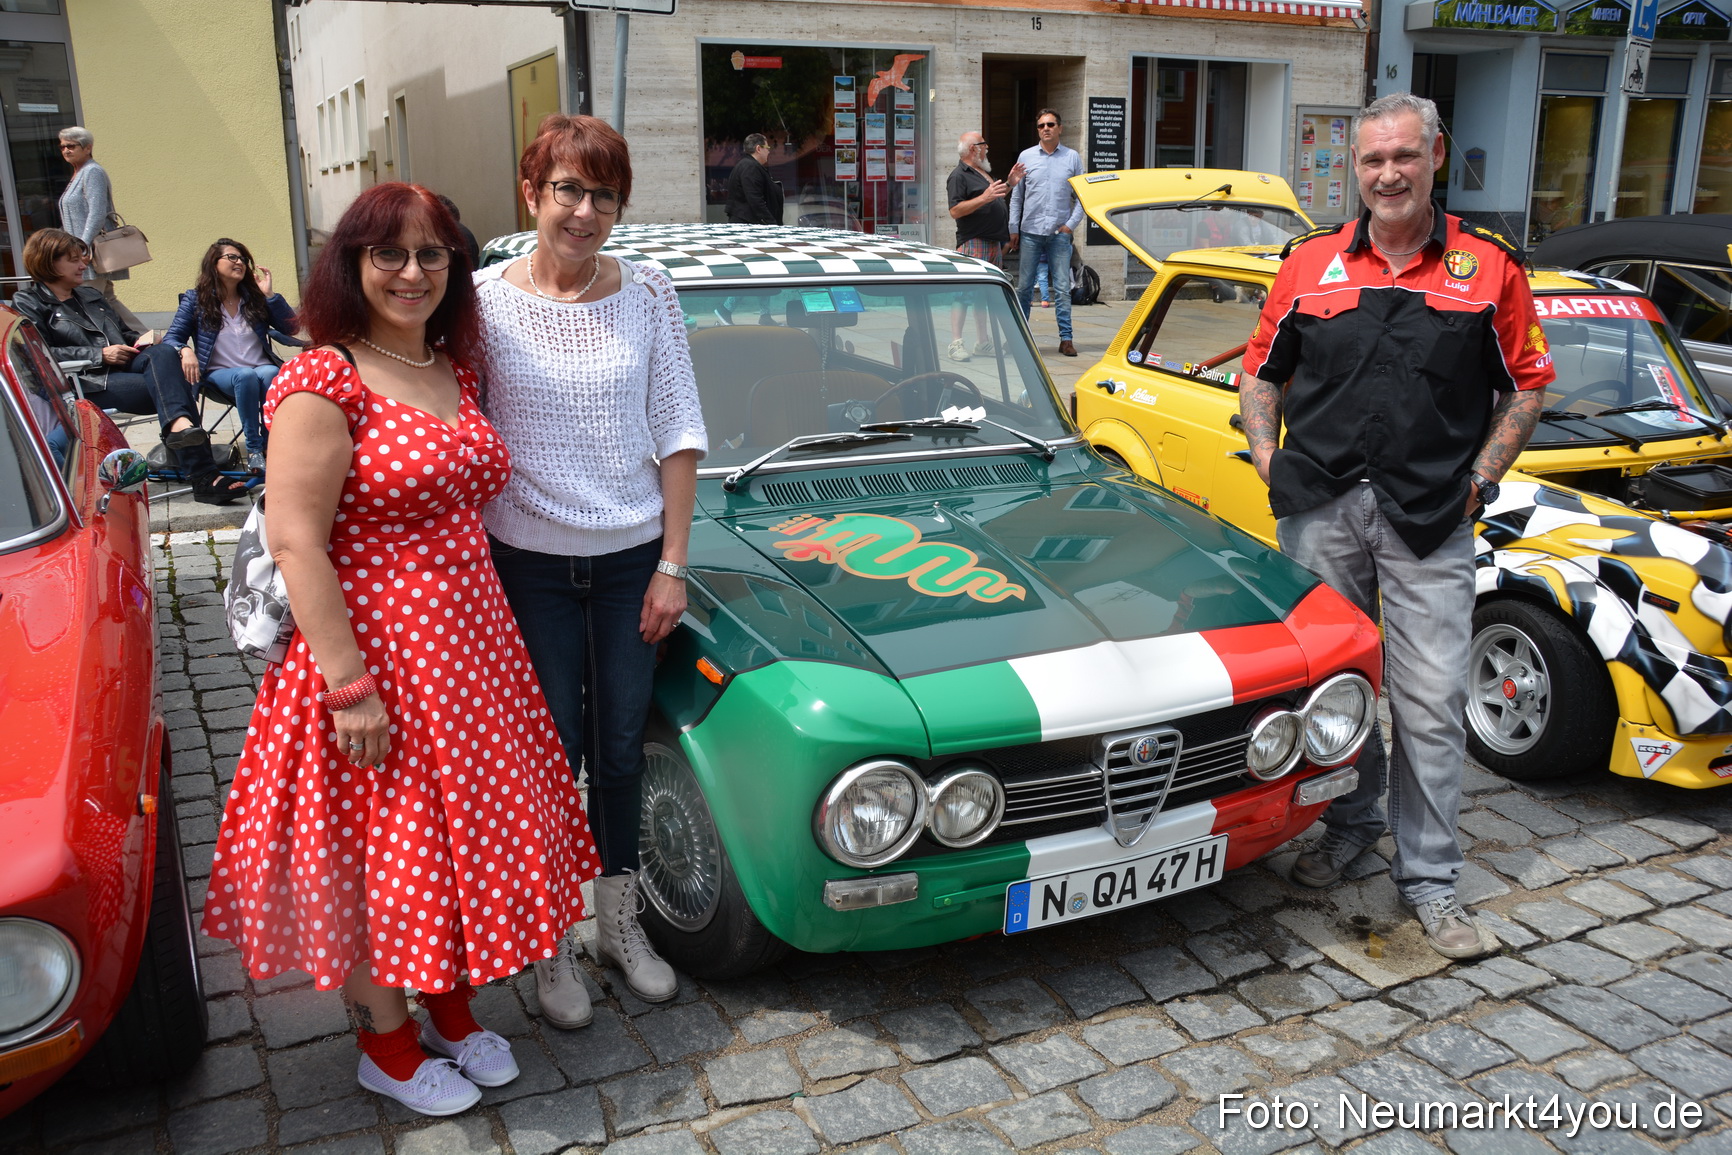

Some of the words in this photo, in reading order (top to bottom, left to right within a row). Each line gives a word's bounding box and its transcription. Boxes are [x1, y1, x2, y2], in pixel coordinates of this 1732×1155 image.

[1031, 16, 1042, 31] 15
[1682, 12, 1707, 25] OPTIK
[1386, 64, 1398, 79] 16
[1444, 279, 1470, 292] Luigi
[1535, 298, 1631, 316] BARTH
[1639, 745, 1671, 755] KONI
[1041, 880, 1068, 921] N
[1092, 866, 1137, 908] QA
[1013, 912, 1022, 924] D
